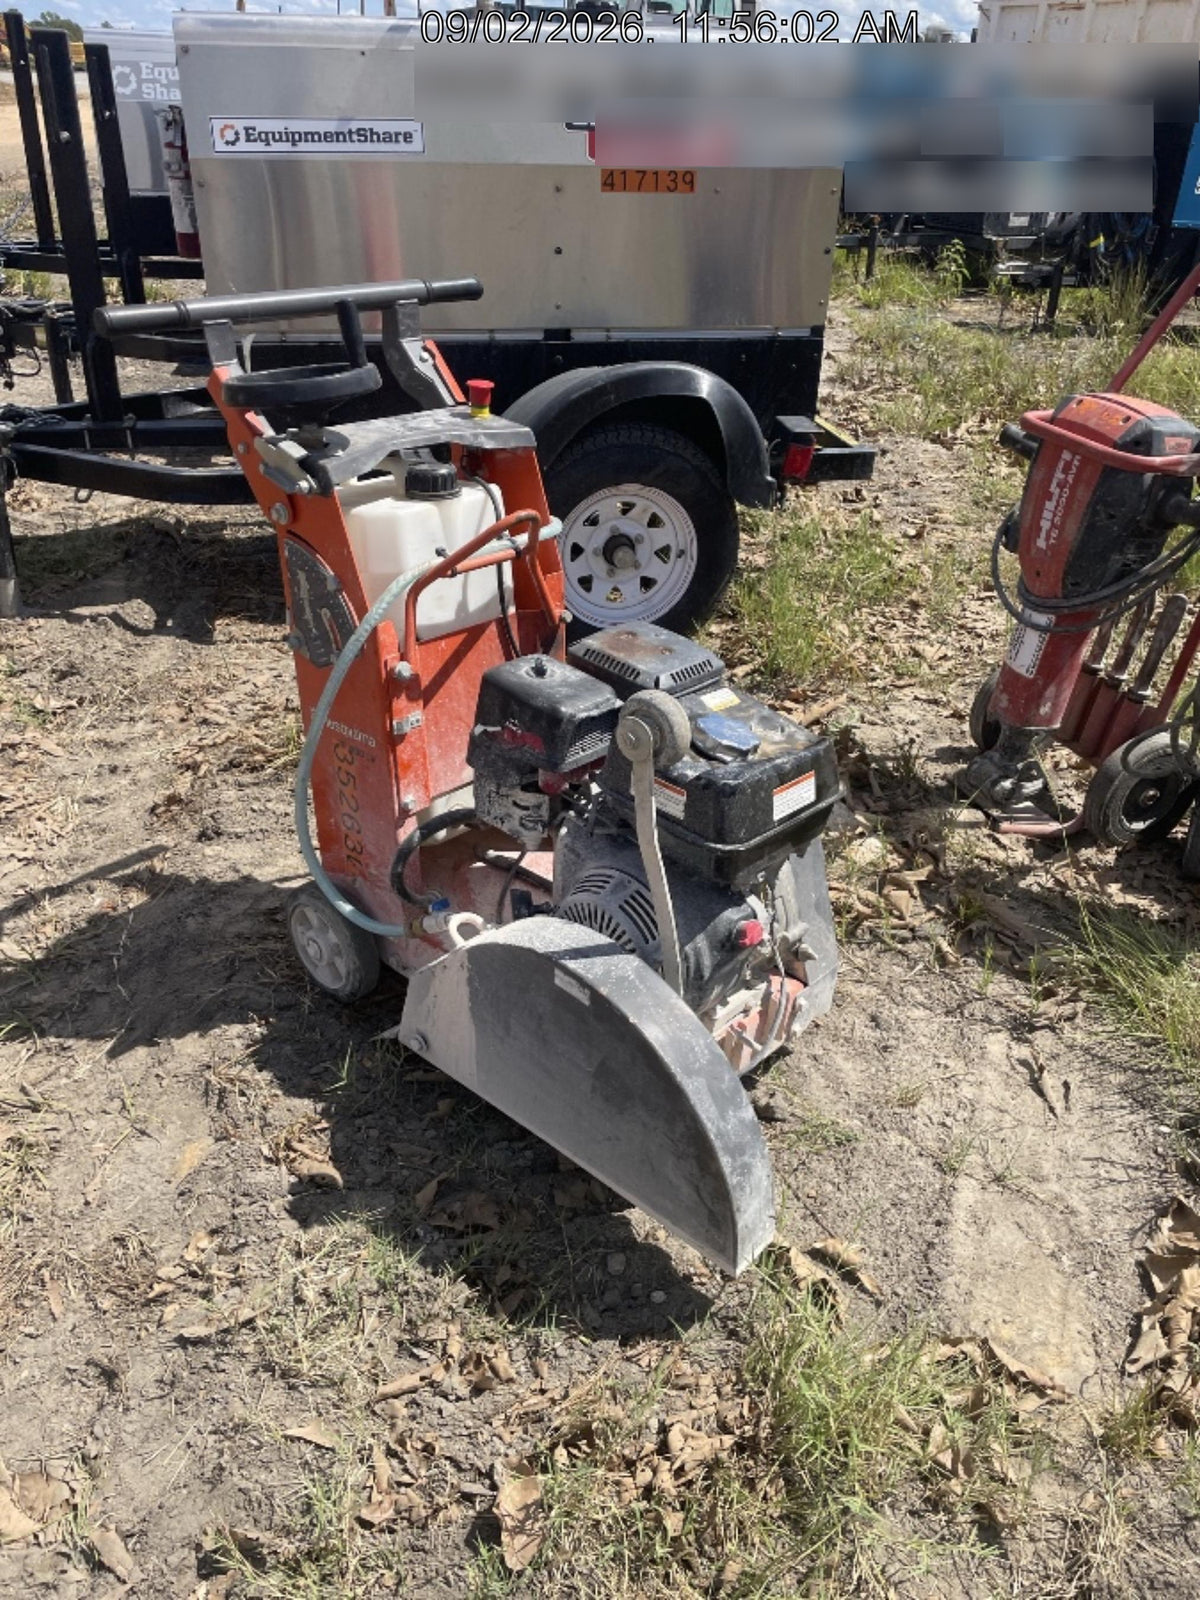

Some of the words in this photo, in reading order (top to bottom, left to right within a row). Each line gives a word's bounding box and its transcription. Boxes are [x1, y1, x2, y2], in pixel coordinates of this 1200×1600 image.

[244, 126, 413, 147] EquipmentShare
[602, 171, 695, 192] 417139
[1036, 449, 1073, 550] HILTI
